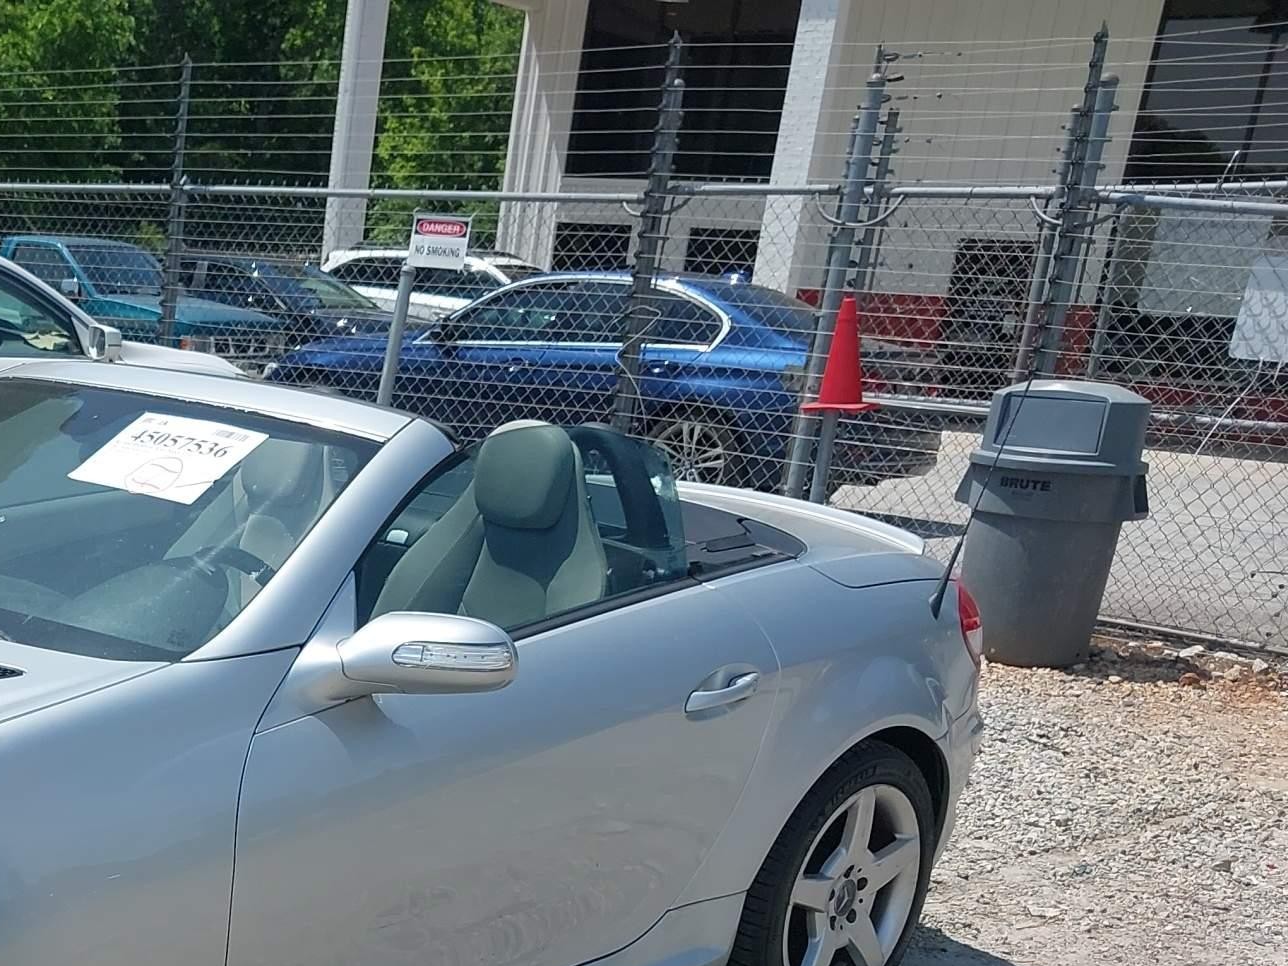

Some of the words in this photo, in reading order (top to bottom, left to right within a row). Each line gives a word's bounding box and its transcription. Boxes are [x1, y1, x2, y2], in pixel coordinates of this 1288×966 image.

[422, 222, 460, 234] DANGER
[415, 245, 424, 255] NO
[425, 245, 460, 257] SMOKING
[131, 430, 233, 458] 45057536
[1000, 476, 1052, 492] BRUTE
